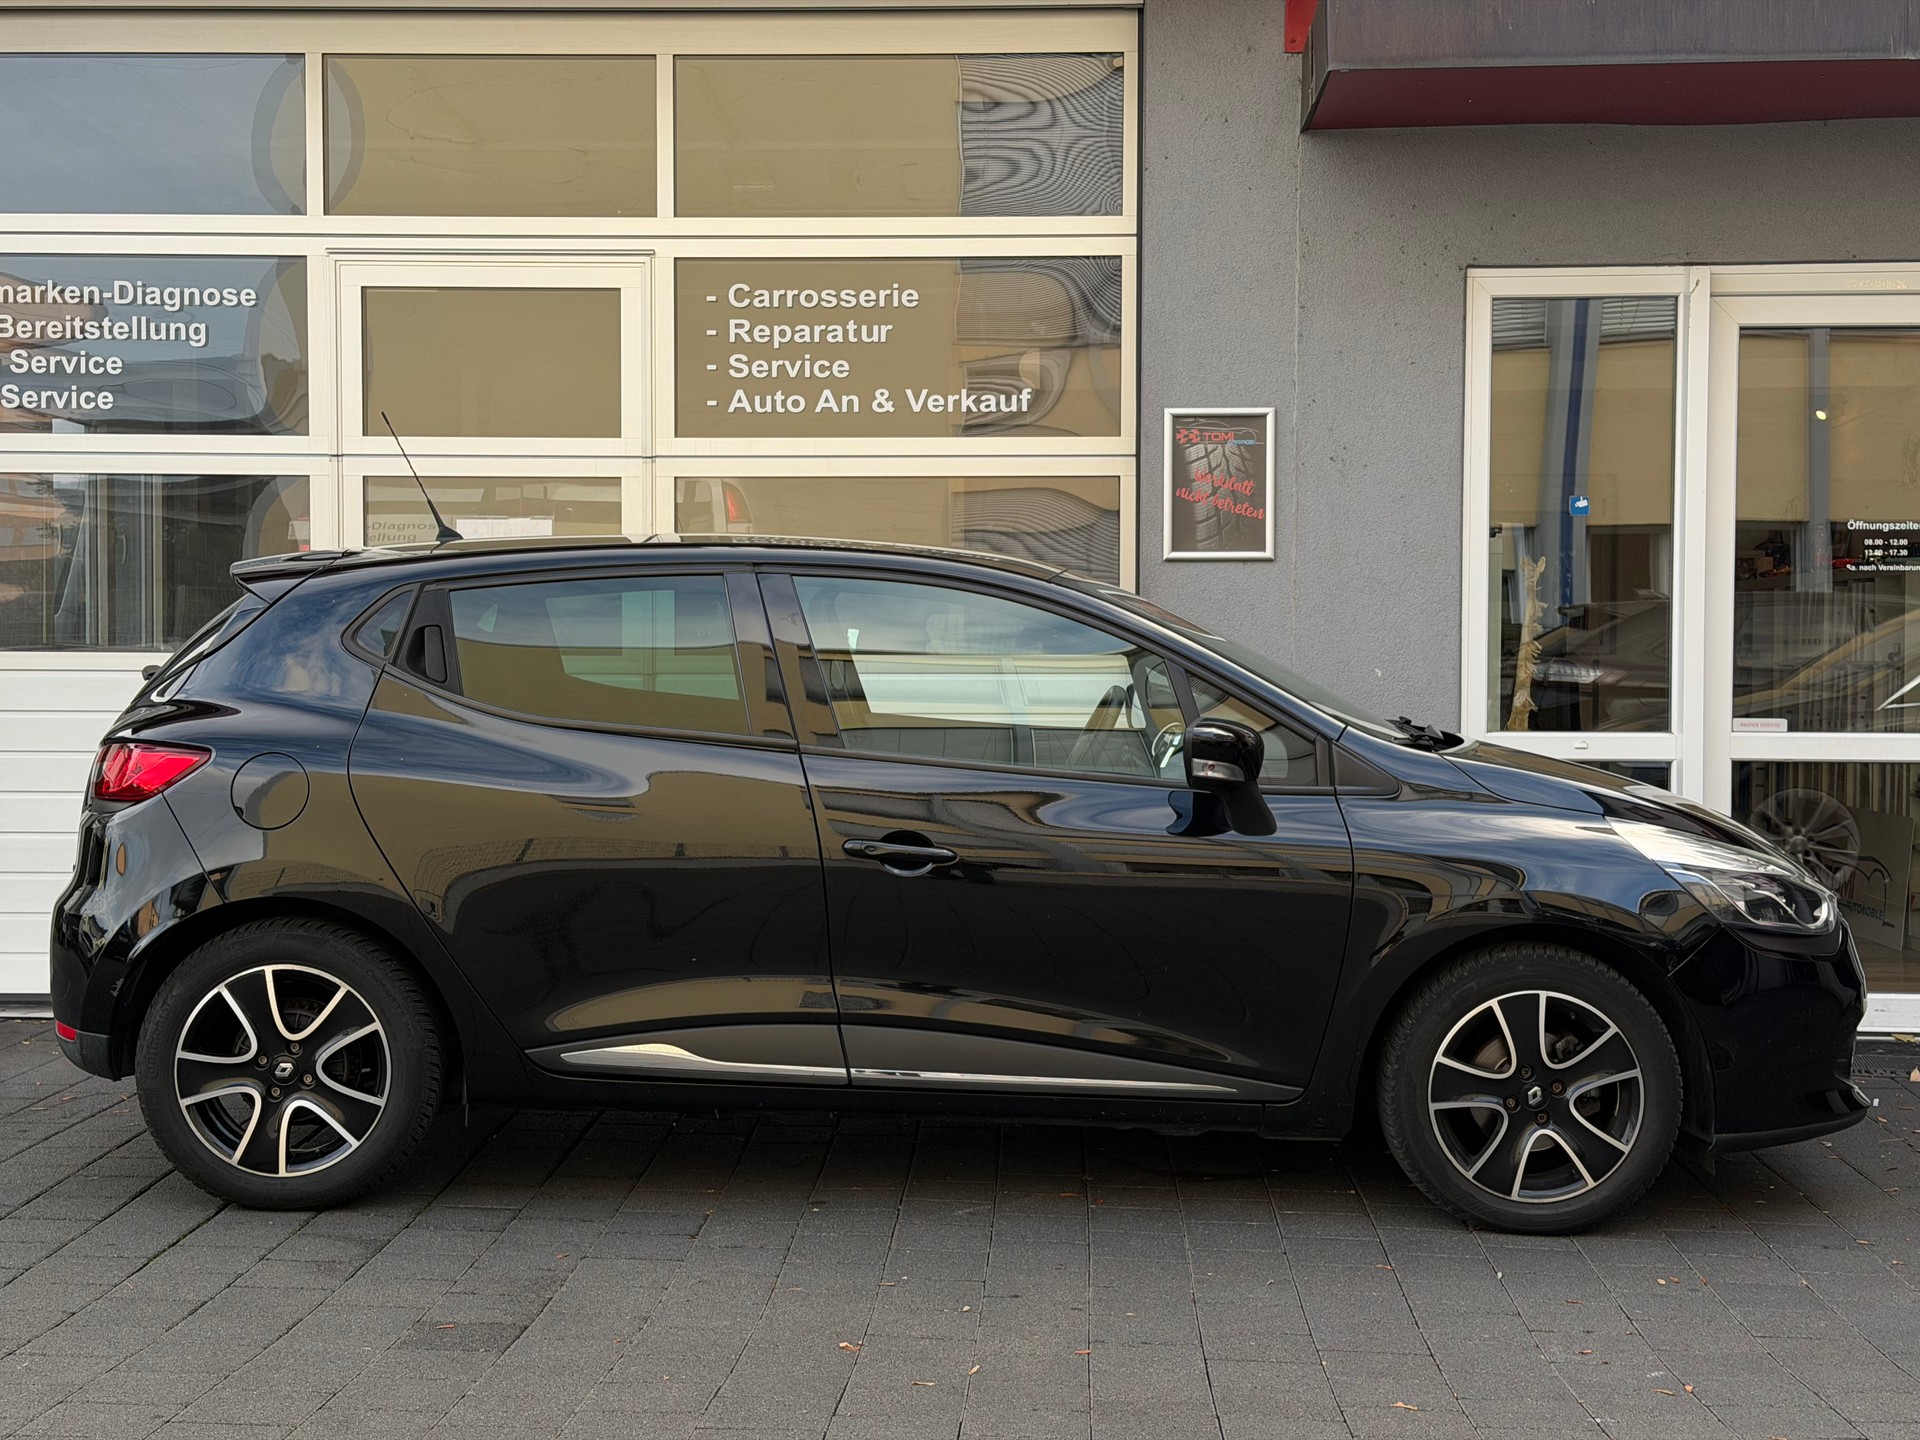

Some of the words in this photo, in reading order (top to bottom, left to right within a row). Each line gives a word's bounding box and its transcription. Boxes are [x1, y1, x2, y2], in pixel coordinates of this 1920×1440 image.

[727, 283, 920, 309] Carrosserie
[728, 318, 893, 349] Reparatur
[9, 349, 124, 375] Service
[728, 353, 850, 379] Service
[0, 384, 115, 410] Service
[727, 389, 807, 414] Auto
[814, 389, 860, 413] An
[871, 389, 896, 414] &
[904, 387, 1033, 414] Verkauf
[1202, 432, 1234, 441] TOMI
[1175, 487, 1211, 505] nicht
[1212, 494, 1264, 520] betreten
[1847, 519, 1920, 532] Öffnungszeite
[1864, 538, 1883, 546] 08.00
[1889, 538, 1908, 546] 12.00
